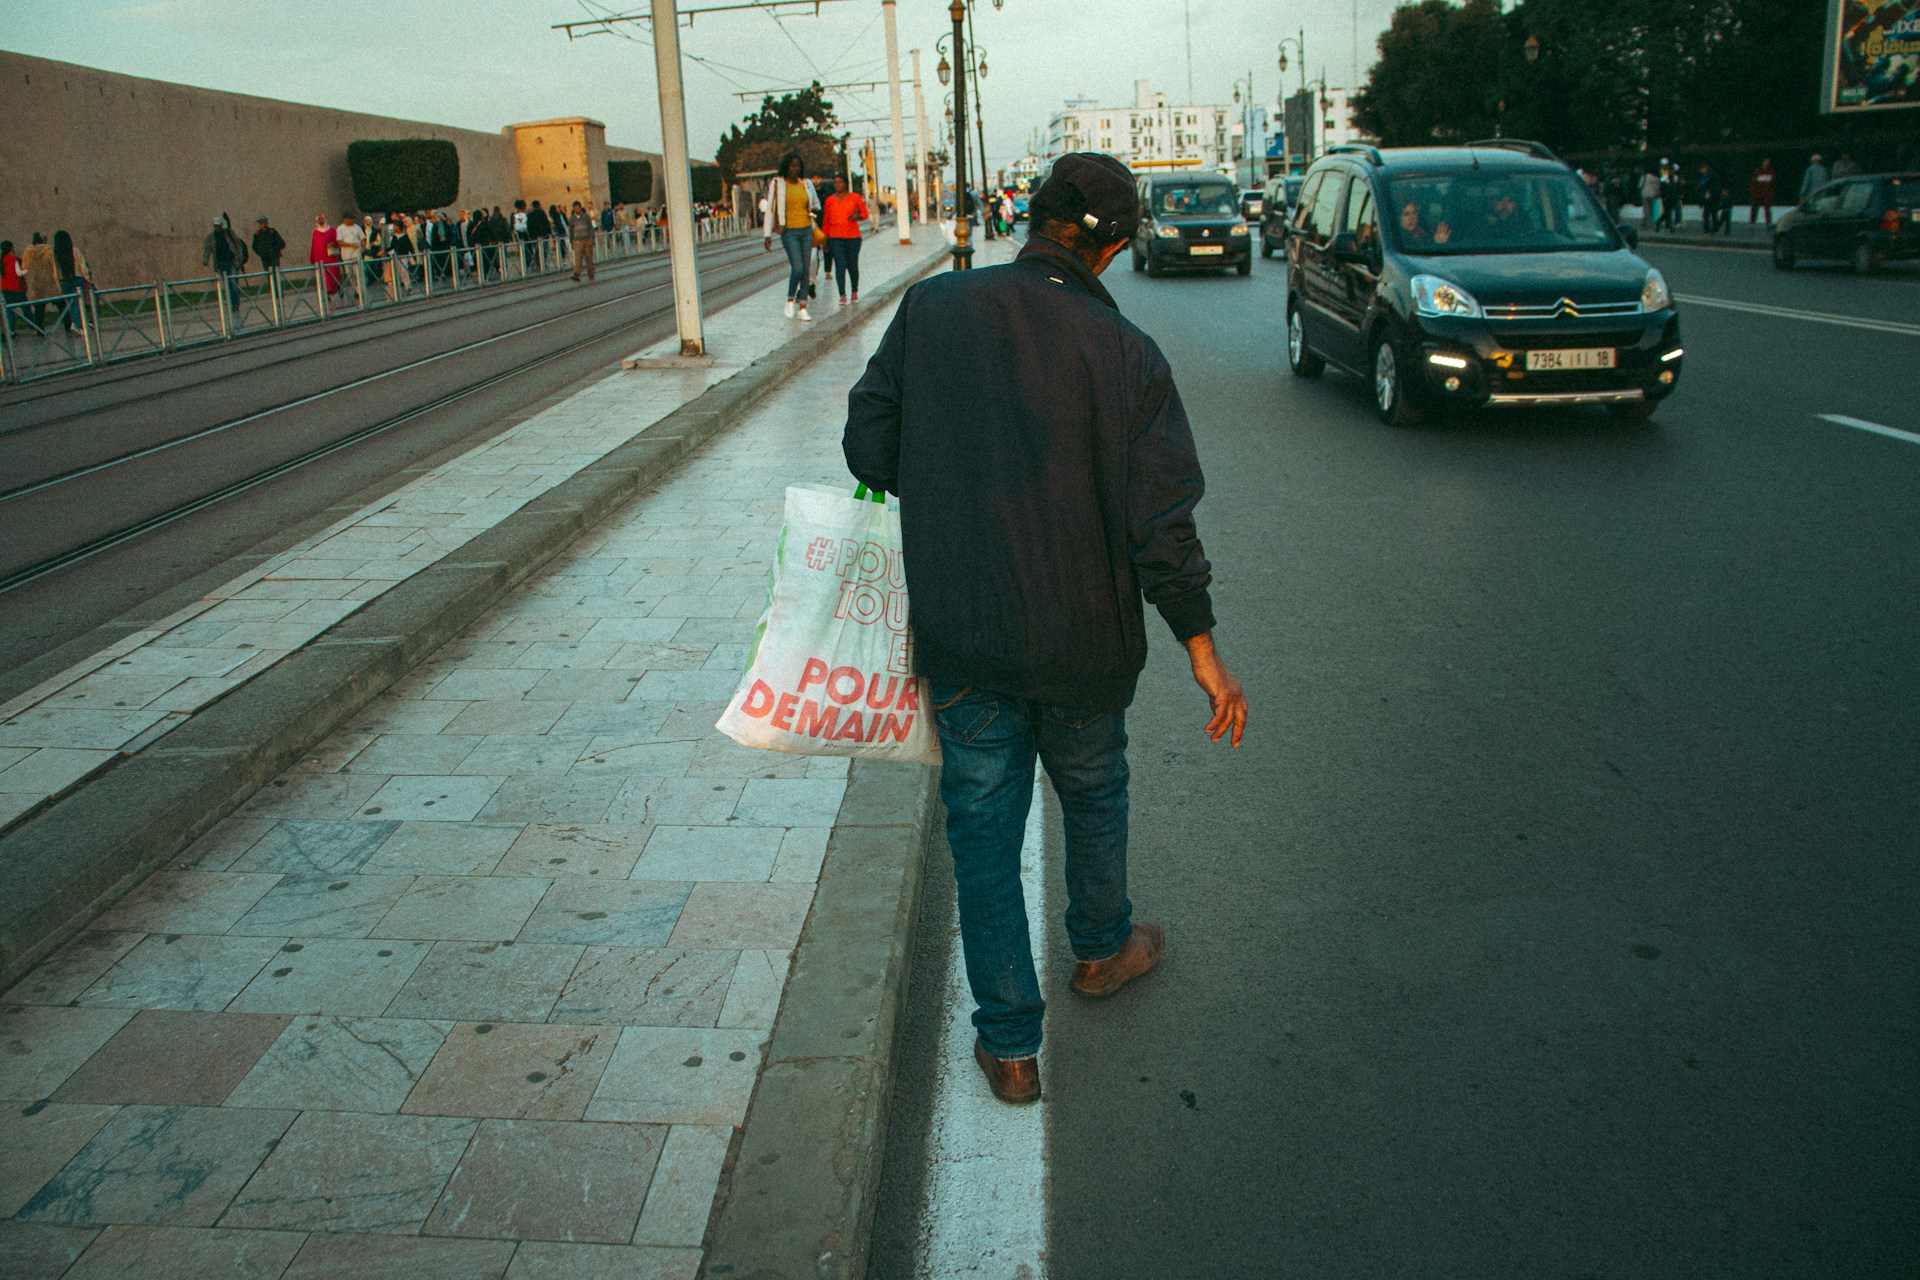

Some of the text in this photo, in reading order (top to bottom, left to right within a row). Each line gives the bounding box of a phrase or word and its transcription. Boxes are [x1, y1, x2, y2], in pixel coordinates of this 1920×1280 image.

[1266, 138, 1277, 151] P
[740, 678, 915, 743] DEMAIN
[797, 657, 920, 711] POUR
